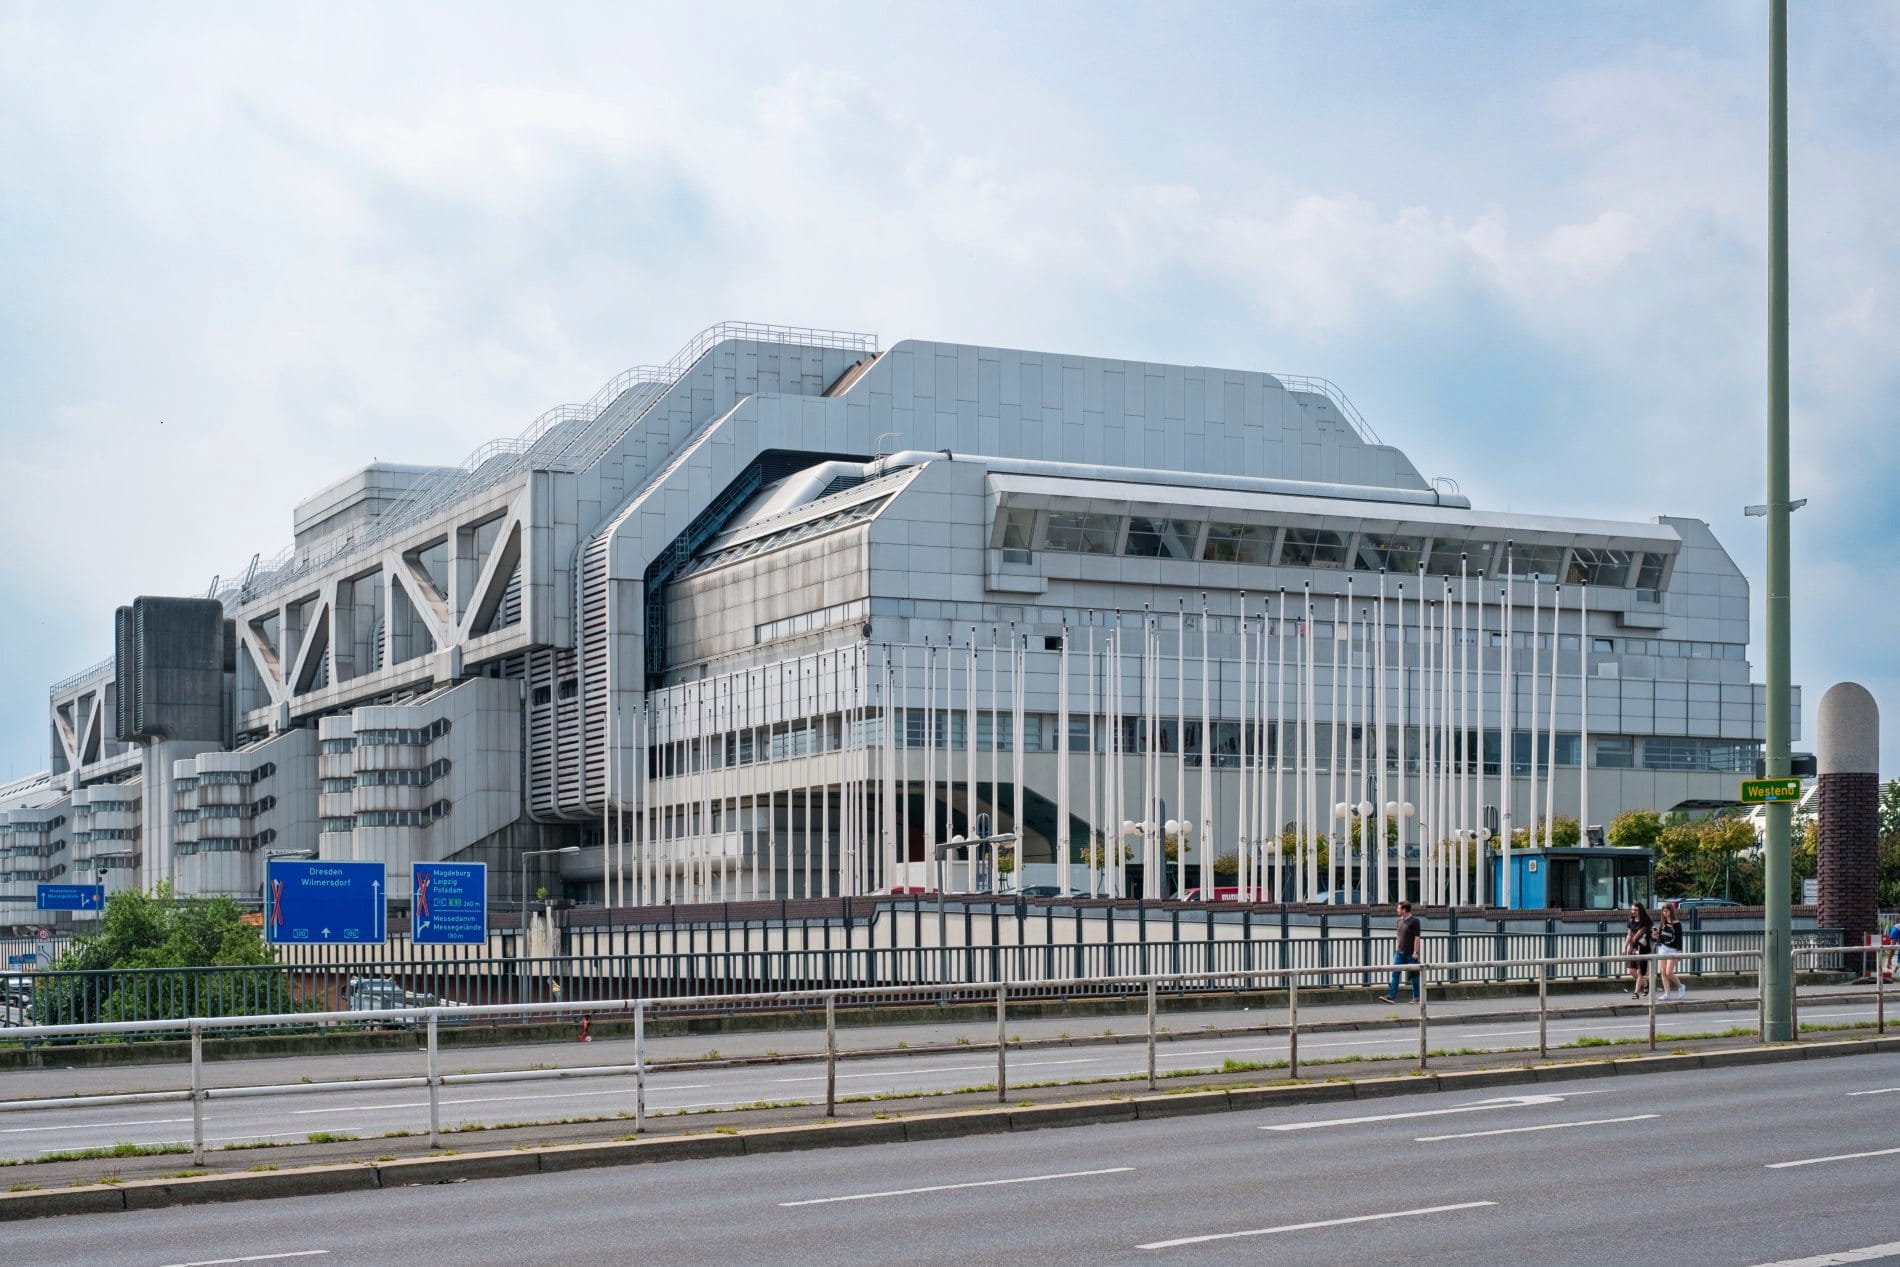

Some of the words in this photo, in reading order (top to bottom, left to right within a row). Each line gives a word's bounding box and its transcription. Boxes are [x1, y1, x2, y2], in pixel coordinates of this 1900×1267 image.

[1748, 785, 1794, 796] Westend
[433, 870, 471, 878] Magdeburg
[301, 878, 351, 886] Wilmersdorf
